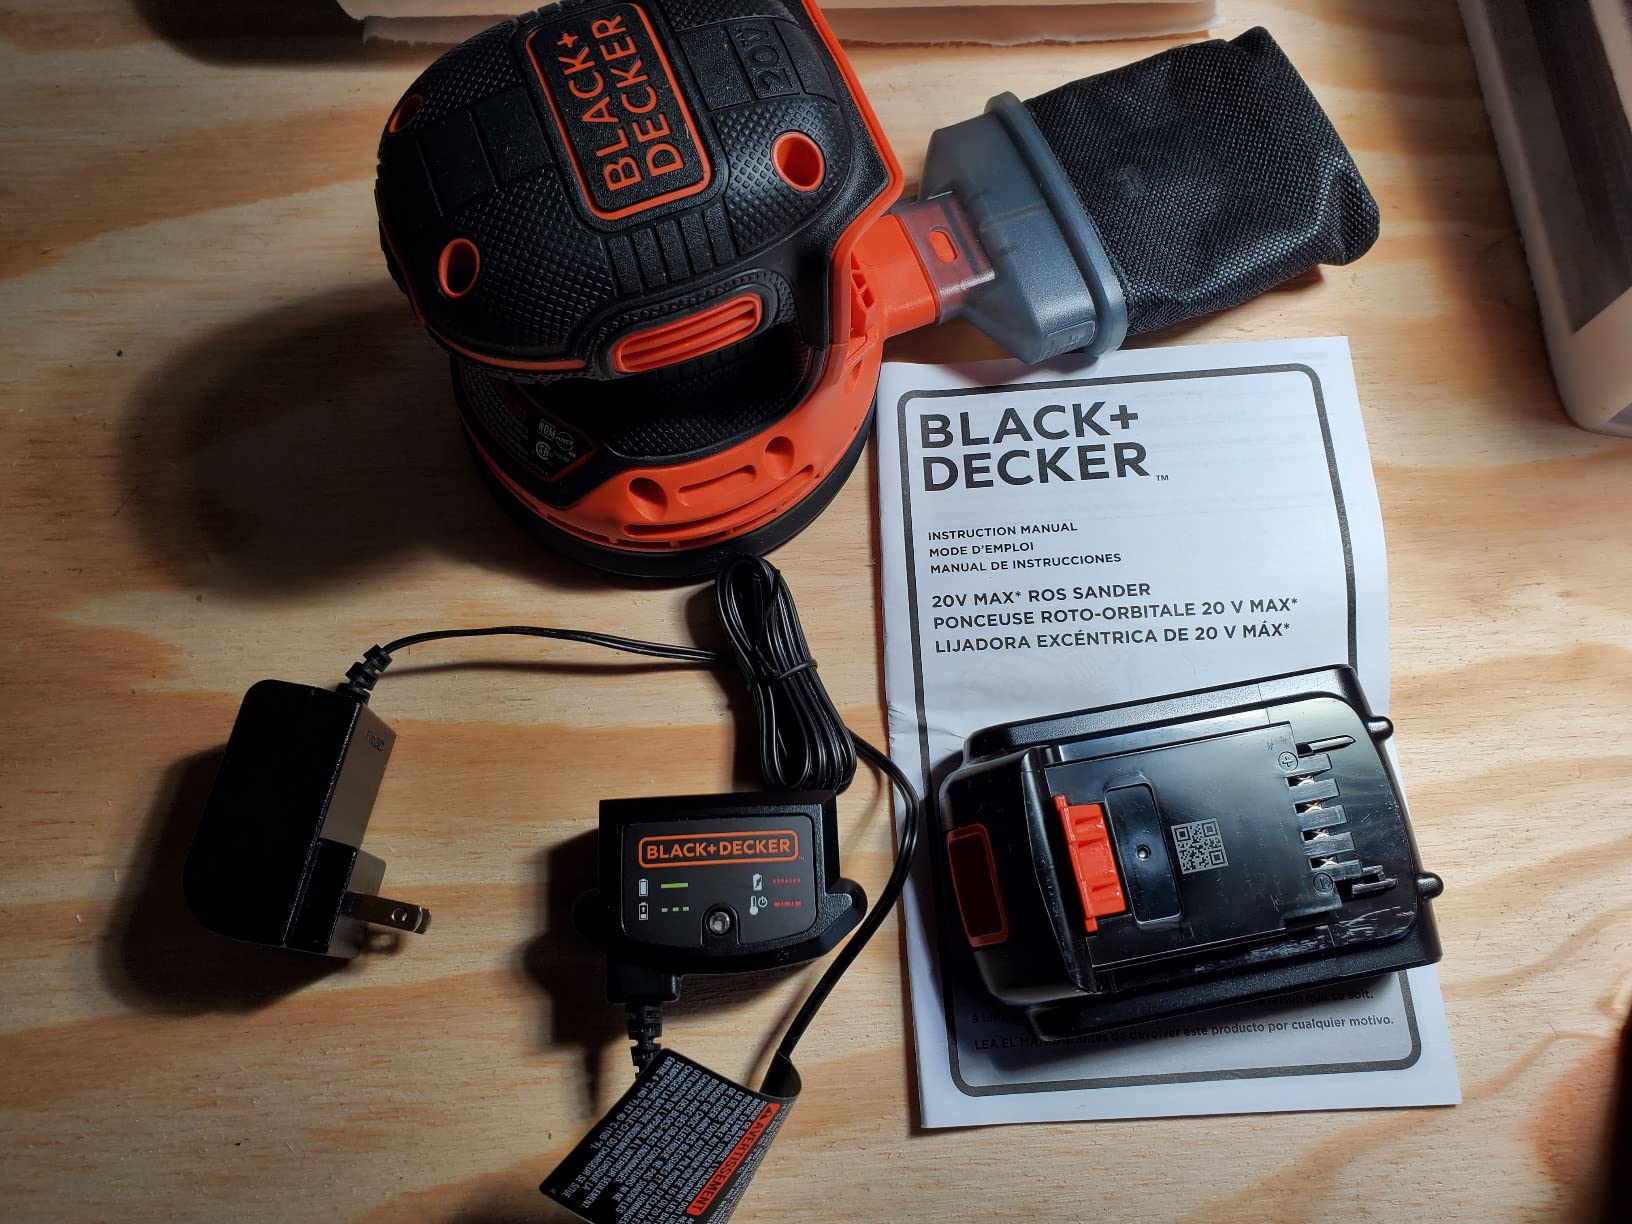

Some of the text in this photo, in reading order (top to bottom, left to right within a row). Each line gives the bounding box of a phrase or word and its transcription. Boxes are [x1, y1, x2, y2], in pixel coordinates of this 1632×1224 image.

[557, 31, 642, 190] BLACK+
[592, 15, 685, 178] DECKER
[920, 402, 1138, 448] BLACK+
[922, 441, 1150, 492] DECKER
[928, 522, 1078, 541] INSTRUCTION MANUAL
[929, 542, 1034, 558] MODE D'EMPLOI
[930, 553, 1122, 574] MANUAL DE INSTRUCCIONES
[932, 594, 968, 608] 20V
[1028, 588, 1067, 603] ROS
[1073, 582, 1151, 600] SANDER
[934, 611, 1034, 630] PONCEUSE
[1040, 602, 1196, 624] ROTO-ORBITALE
[1202, 601, 1224, 615] 20
[1231, 600, 1244, 614] V
[935, 635, 1031, 653] LIJADORA
[1037, 629, 1157, 648] EXCÉNTRICA
[1164, 628, 1189, 642] DE
[1194, 626, 1218, 641] 20
[1224, 625, 1236, 639] V
[647, 839, 790, 860] BLACK+DECKER
[974, 1038, 999, 1050] LEA
[1001, 1038, 1017, 1049] EL
[1183, 1025, 1208, 1037] este
[1211, 1021, 1264, 1036] producto
[1267, 1022, 1287, 1032] por
[1291, 1016, 1345, 1032] cualquier
[1349, 1013, 1393, 1027] motivo.
[691, 1121, 765, 1211] AVERTISSEMENT
